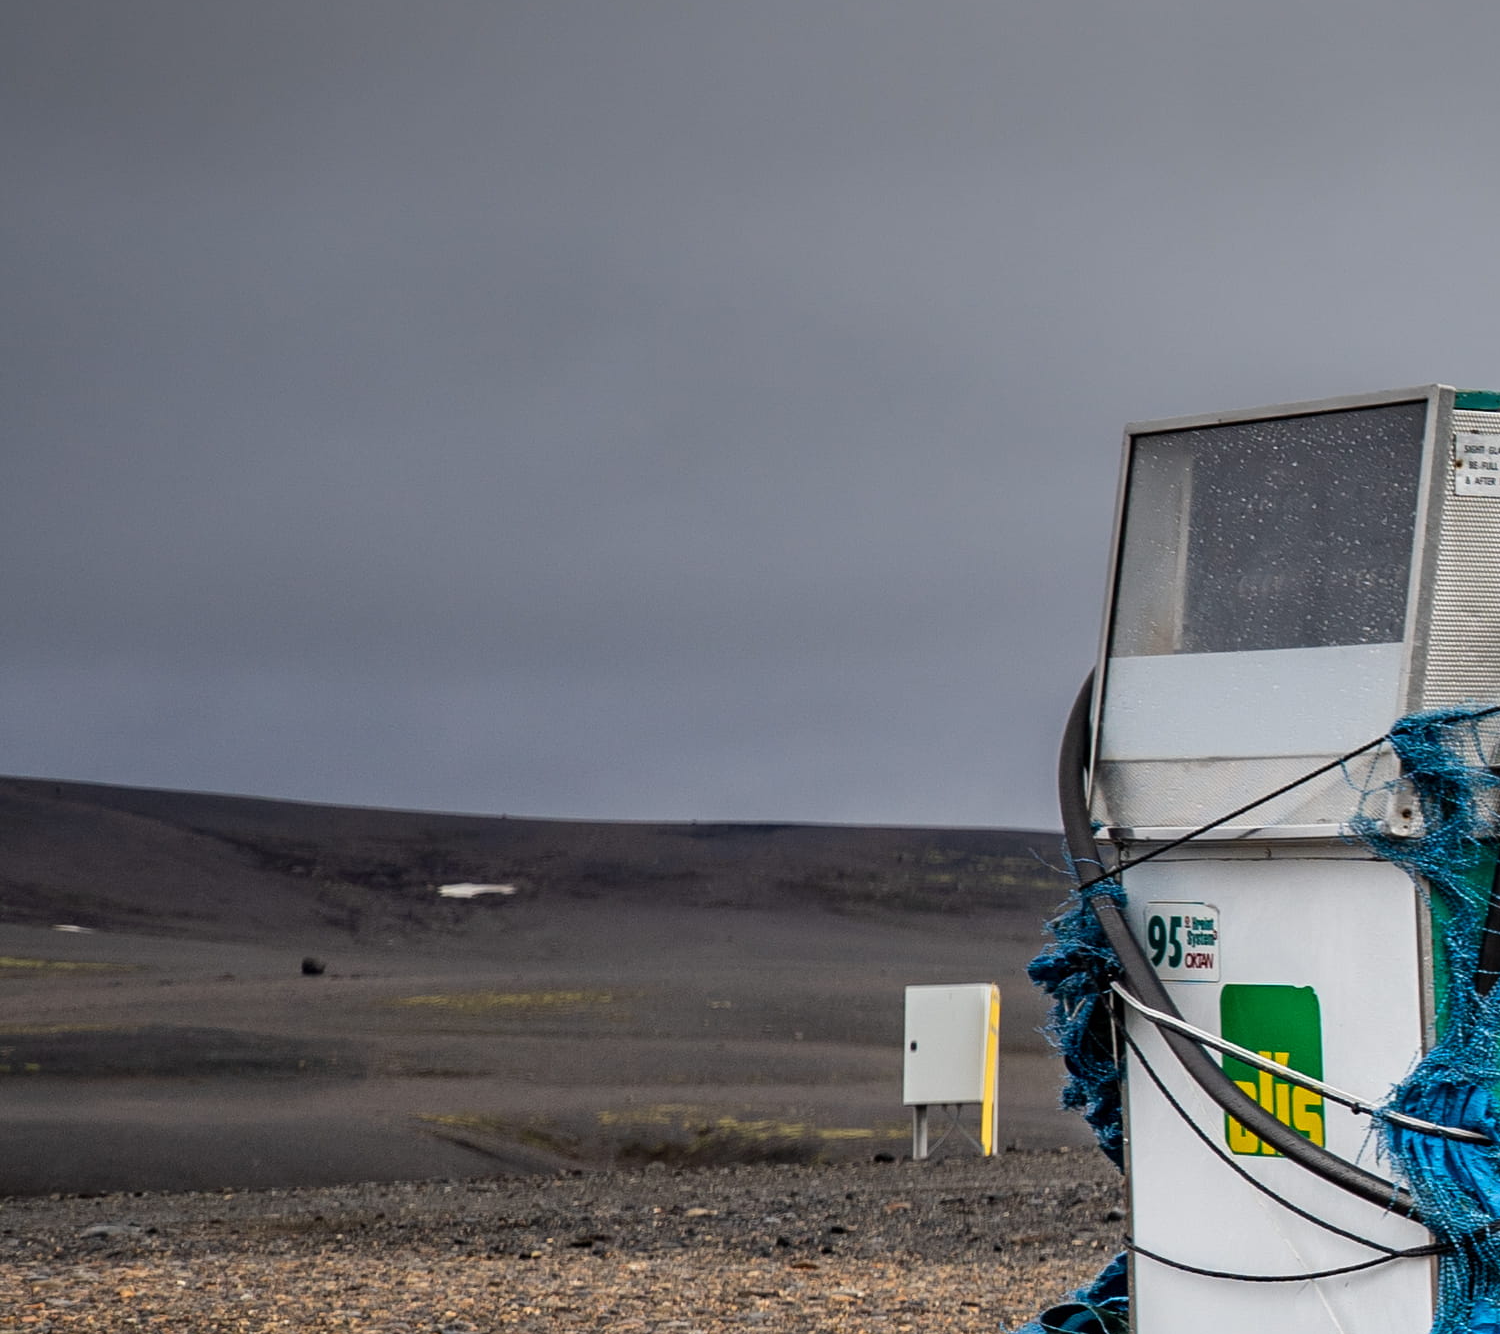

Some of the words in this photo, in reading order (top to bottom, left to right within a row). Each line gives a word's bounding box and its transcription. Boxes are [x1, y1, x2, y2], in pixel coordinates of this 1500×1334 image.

[1464, 445, 1485, 454] SIGHT
[1469, 461, 1478, 470] BE
[1482, 462, 1498, 471] FULL
[1475, 477, 1496, 485] AFTER
[1148, 915, 1183, 968] 95
[1185, 952, 1214, 969] OKTAN
